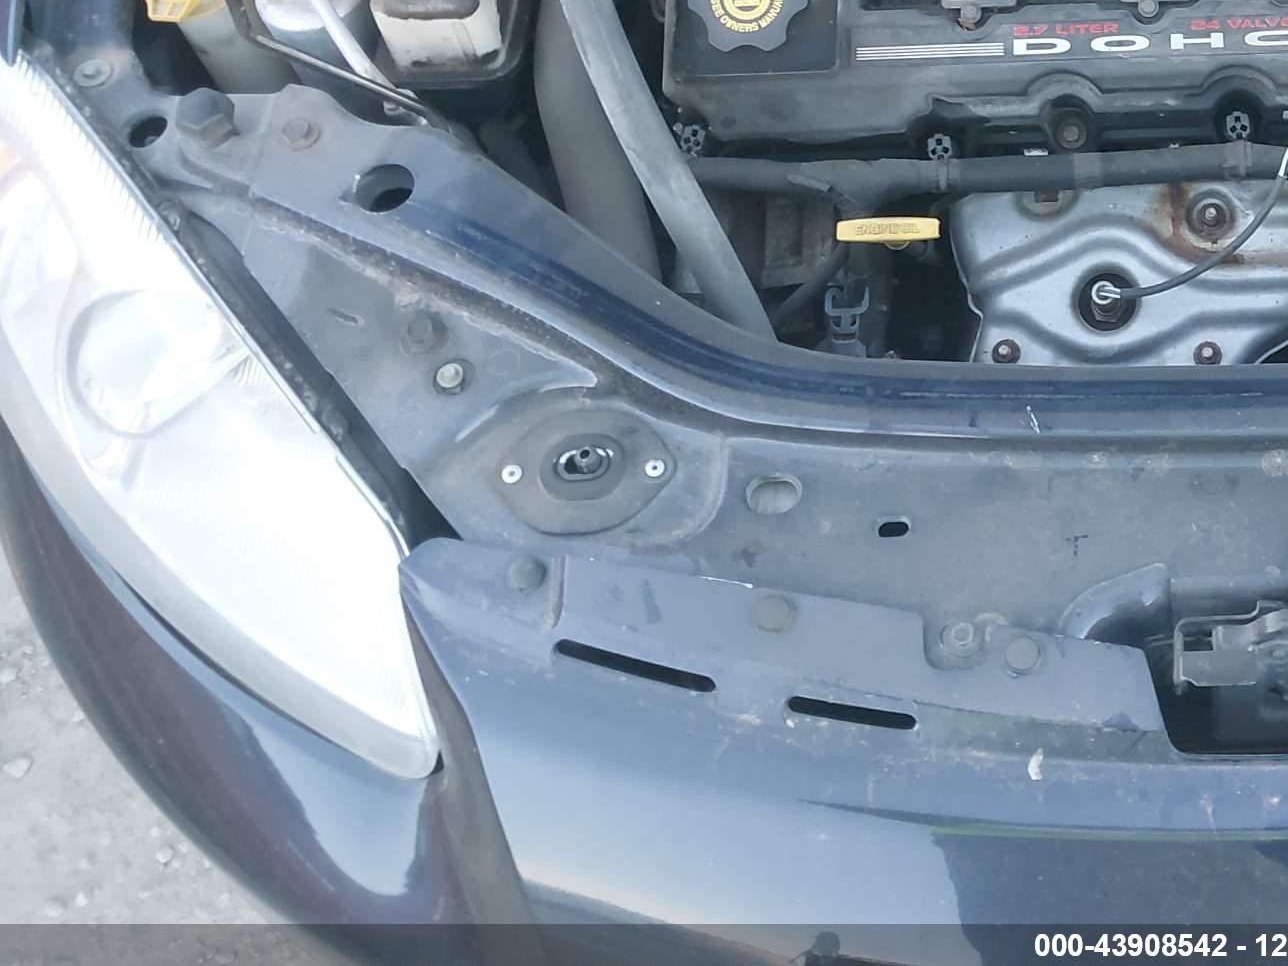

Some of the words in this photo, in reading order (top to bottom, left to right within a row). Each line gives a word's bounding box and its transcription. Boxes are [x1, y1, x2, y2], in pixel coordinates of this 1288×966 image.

[719, 14, 760, 33] OWNERS
[1013, 24, 1048, 36] 2.7
[1055, 22, 1120, 35] LITER
[1190, 19, 1221, 31] 24
